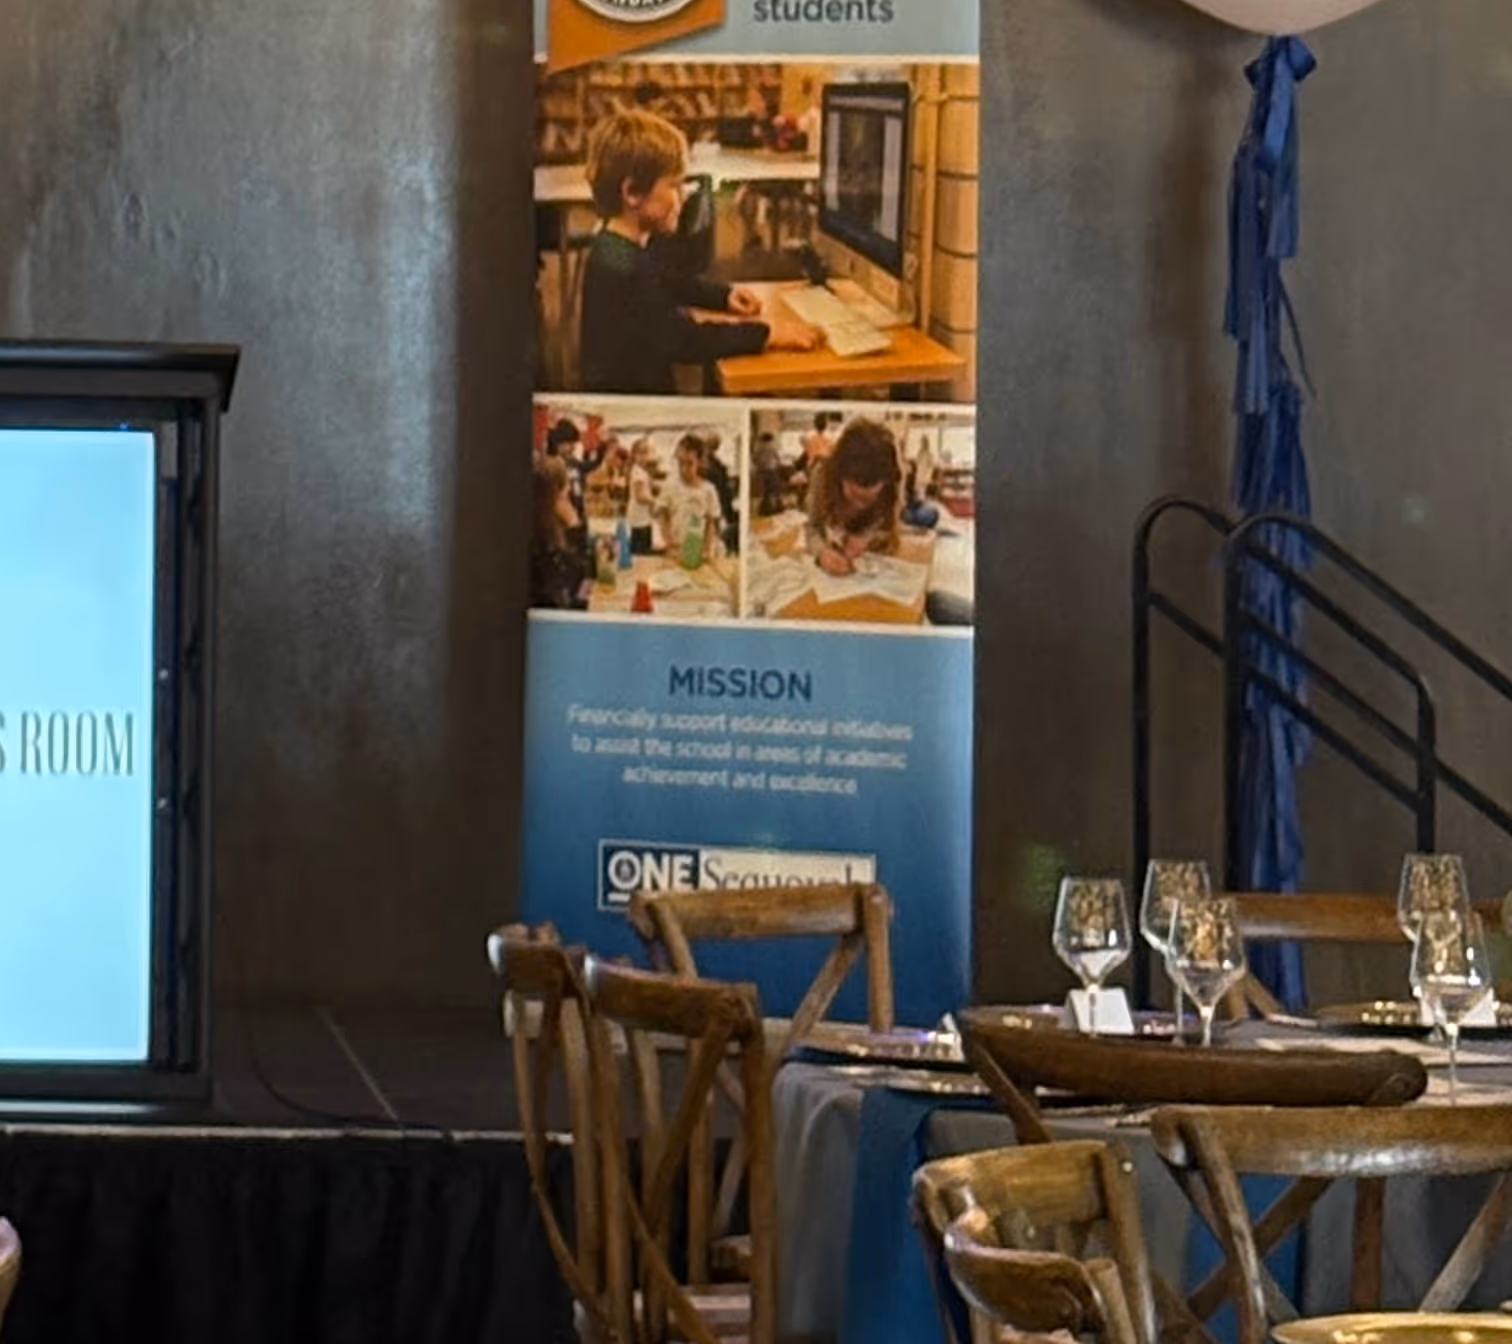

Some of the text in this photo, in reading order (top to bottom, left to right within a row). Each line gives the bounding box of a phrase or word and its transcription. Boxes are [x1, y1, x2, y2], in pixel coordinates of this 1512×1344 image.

[667, 664, 813, 702] MISSION
[660, 712, 728, 734] support
[729, 714, 828, 736] educational
[19, 709, 135, 778] ROOM
[571, 733, 908, 769] to assist the school in areas of academic
[621, 765, 859, 796] achievement and excellence
[607, 849, 694, 894] ONE
